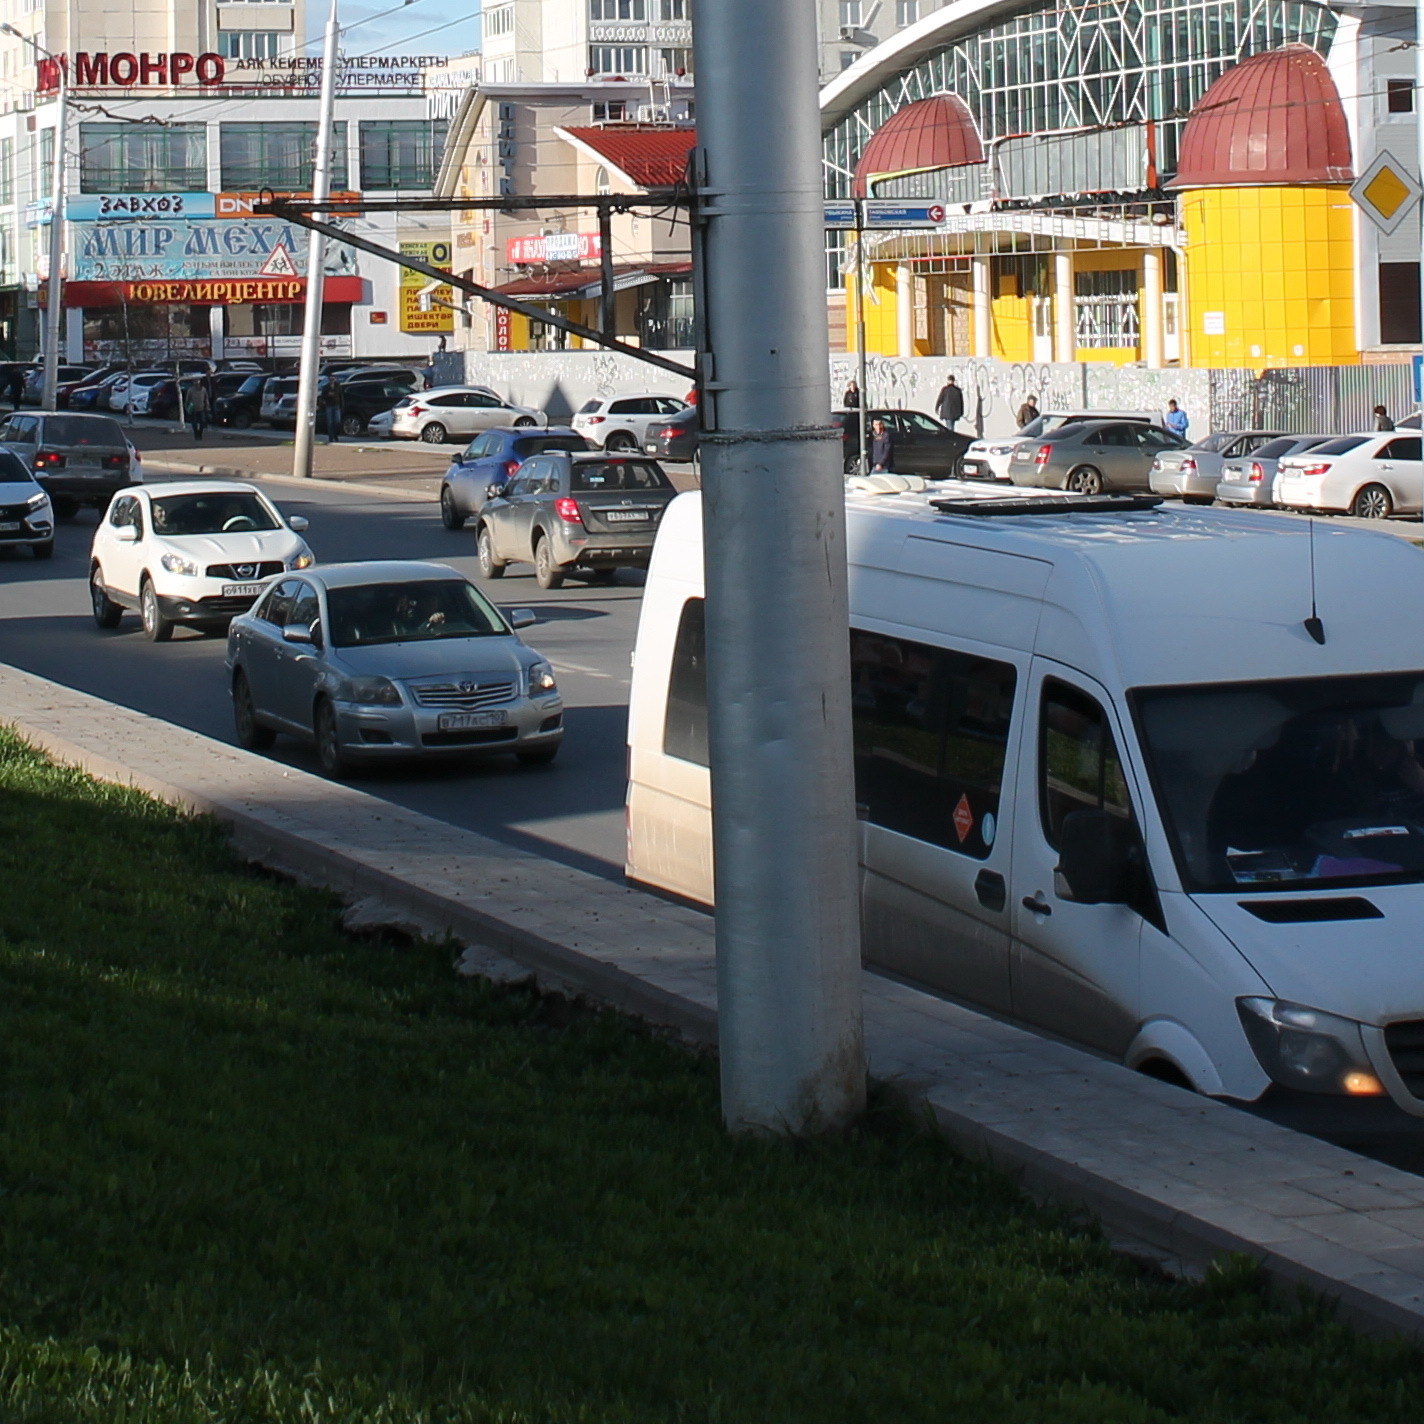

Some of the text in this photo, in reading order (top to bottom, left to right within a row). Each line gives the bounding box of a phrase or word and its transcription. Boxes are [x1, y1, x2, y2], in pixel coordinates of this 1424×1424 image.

[76, 52, 226, 86] МОНРО
[99, 195, 184, 214] ЗАВХОЗ
[83, 226, 298, 256] МИР МЕХА
[109, 264, 165, 277] ЭТАЖ
[130, 281, 301, 304] ЮВЕЛИРЦЕНТР
